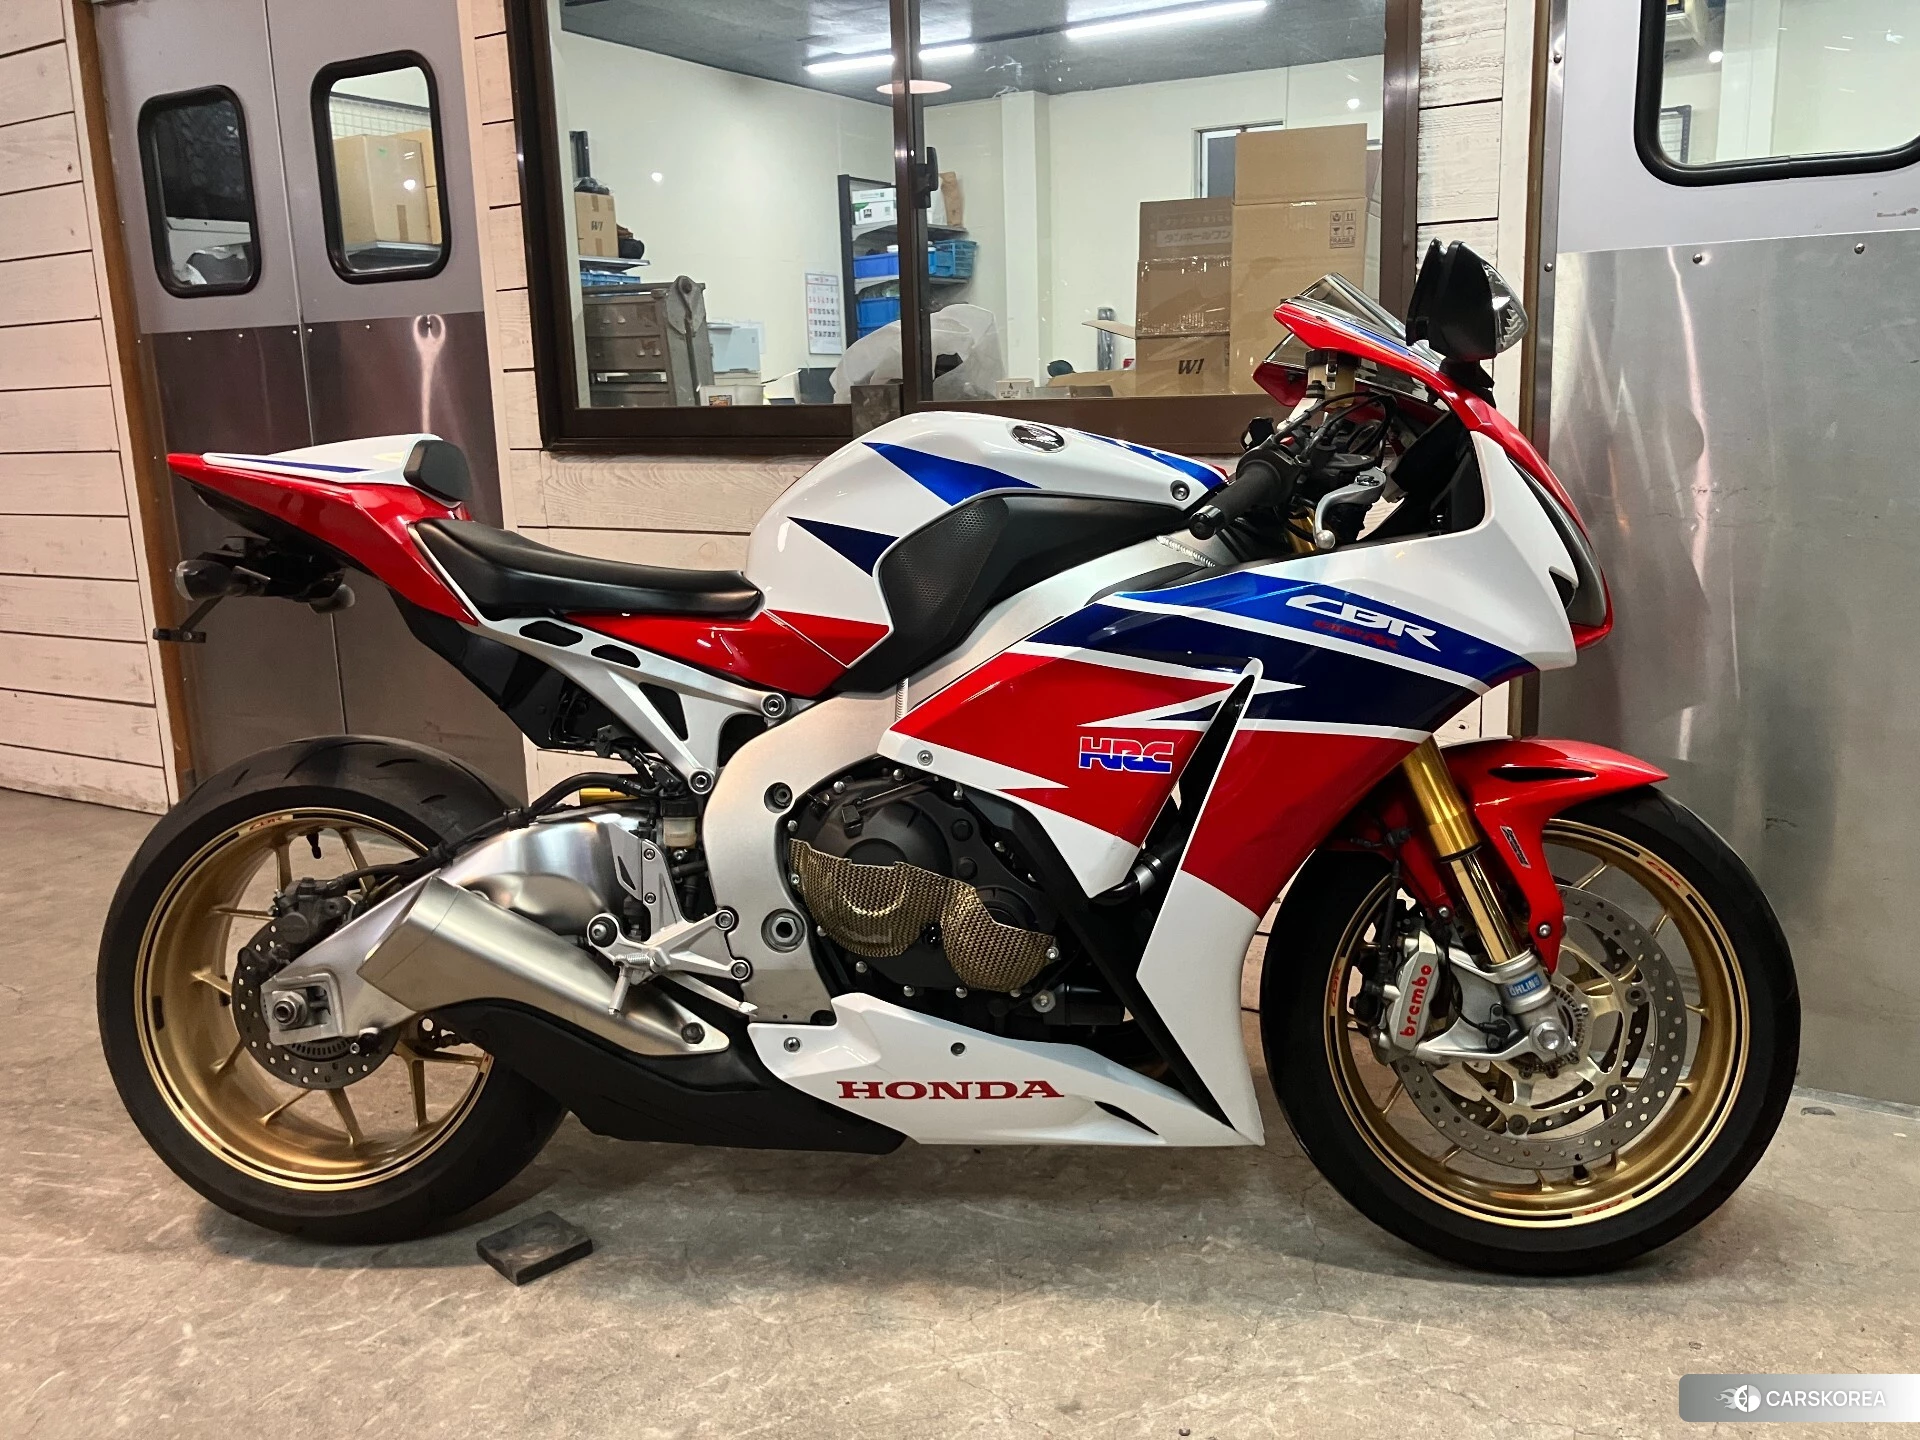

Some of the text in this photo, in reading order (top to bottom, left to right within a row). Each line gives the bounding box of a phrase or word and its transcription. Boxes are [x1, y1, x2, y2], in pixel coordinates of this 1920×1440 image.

[1285, 594, 1442, 652] CBR
[1078, 736, 1175, 774] HRC
[1399, 964, 1432, 1037] brembo
[836, 1080, 1065, 1100] HONDA
